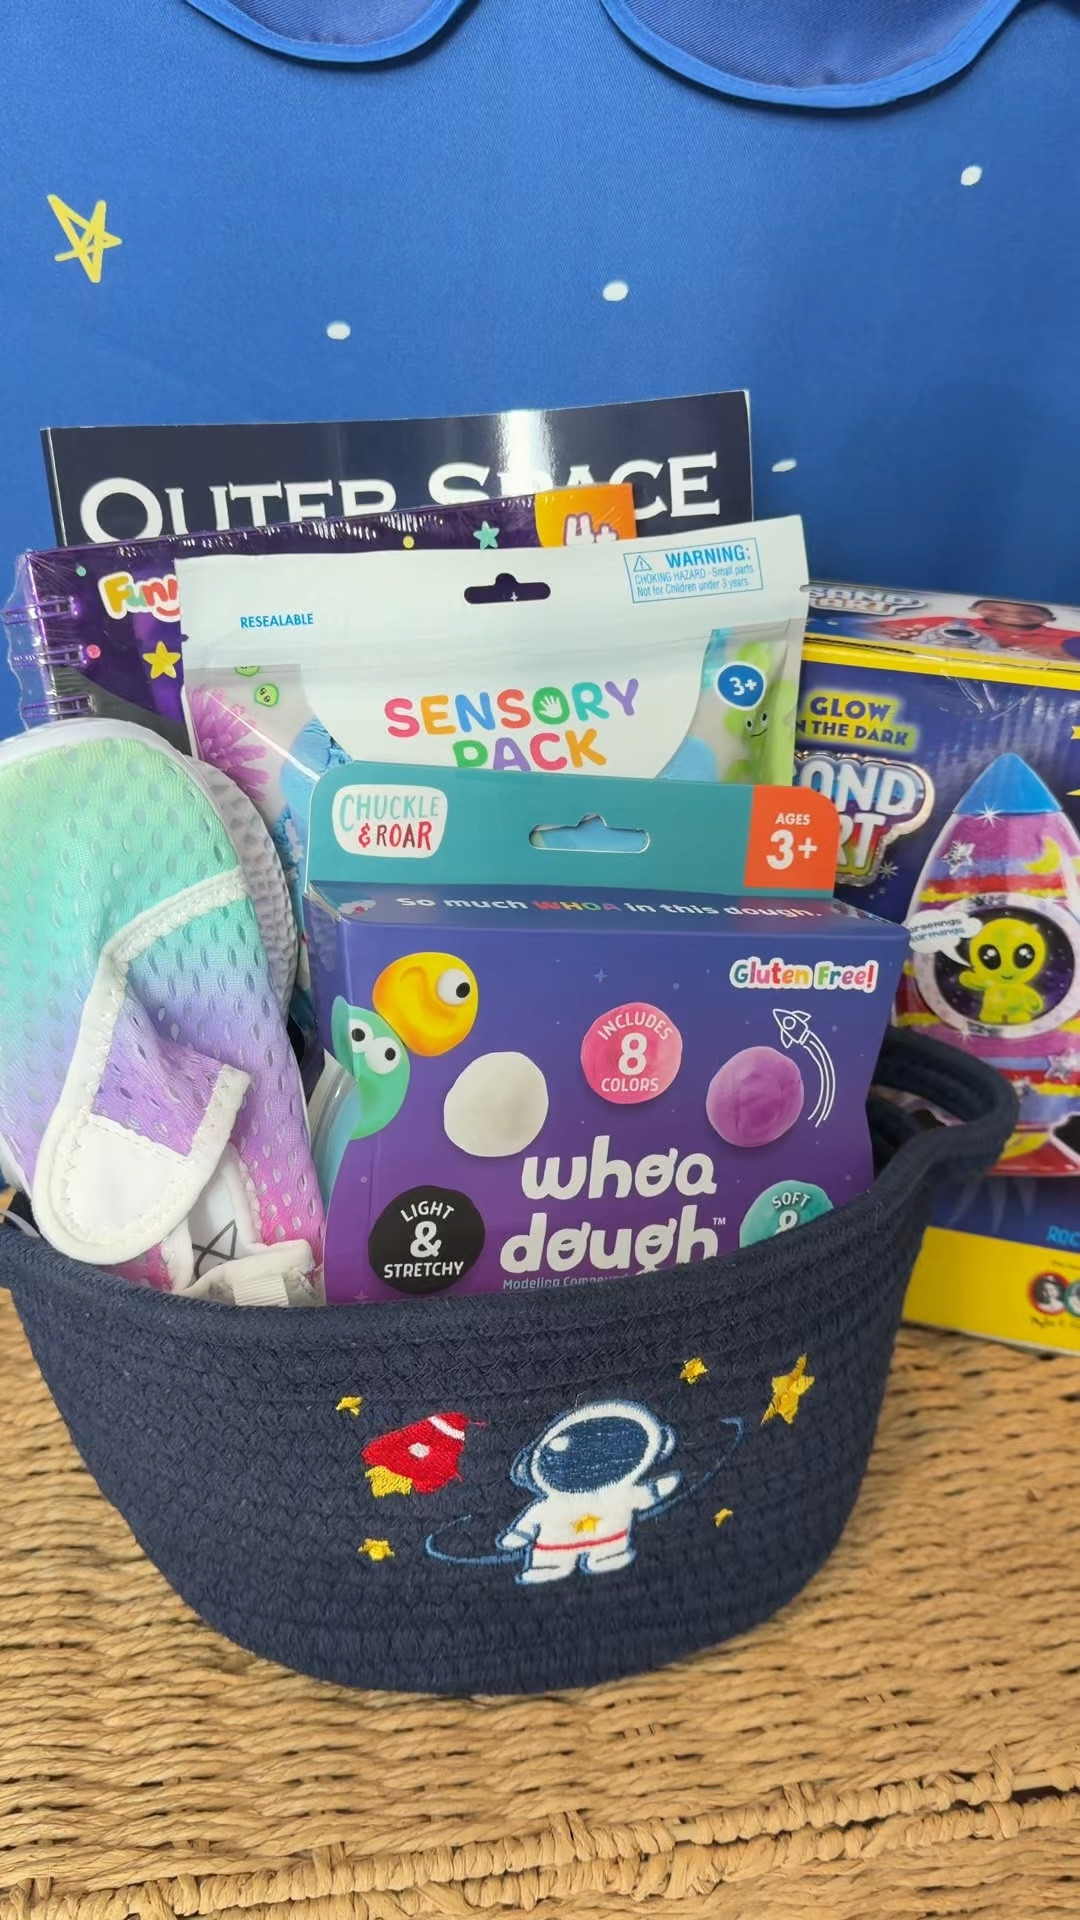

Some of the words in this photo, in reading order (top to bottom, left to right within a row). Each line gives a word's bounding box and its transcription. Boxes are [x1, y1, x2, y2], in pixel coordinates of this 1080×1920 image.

[665, 544, 751, 568] WARNING:
[635, 571, 672, 585] CHOKING
[673, 568, 706, 580] HAZARD
[711, 566, 734, 577] Small
[734, 563, 754, 576] parts
[637, 585, 651, 598] Not
[652, 585, 664, 596] for
[665, 582, 697, 595] Children
[699, 580, 720, 591] under
[240, 613, 314, 629] RESEALABLE
[729, 675, 757, 696] 3+
[384, 677, 640, 738] SENSORY
[810, 696, 892, 722] GLOW
[811, 721, 850, 737] THE
[854, 725, 909, 747] DARK
[452, 727, 608, 772] PACK
[795, 758, 916, 817] AND
[339, 793, 441, 832] CHUCKLE
[775, 812, 812, 826] AGES
[357, 822, 372, 848] &
[376, 820, 433, 850] ROAR
[766, 828, 819, 871] 3+
[396, 896, 436, 907] So
[444, 897, 528, 910] much
[534, 900, 621, 912] WHOA
[623, 901, 657, 914] in
[660, 902, 720, 916] this
[724, 906, 823, 919] dough.
[732, 959, 811, 985] Gluten
[815, 963, 876, 988] Free!
[597, 1011, 673, 1041] INCLUDES
[617, 1031, 649, 1077] 8
[601, 1077, 660, 1093] COLORS
[521, 1135, 717, 1200] whoa
[400, 1200, 455, 1222] LIGHT
[771, 1191, 811, 1209] SOFT
[409, 1220, 443, 1258] &
[500, 1204, 719, 1276] dough
[383, 1260, 465, 1279] STRETCHY
